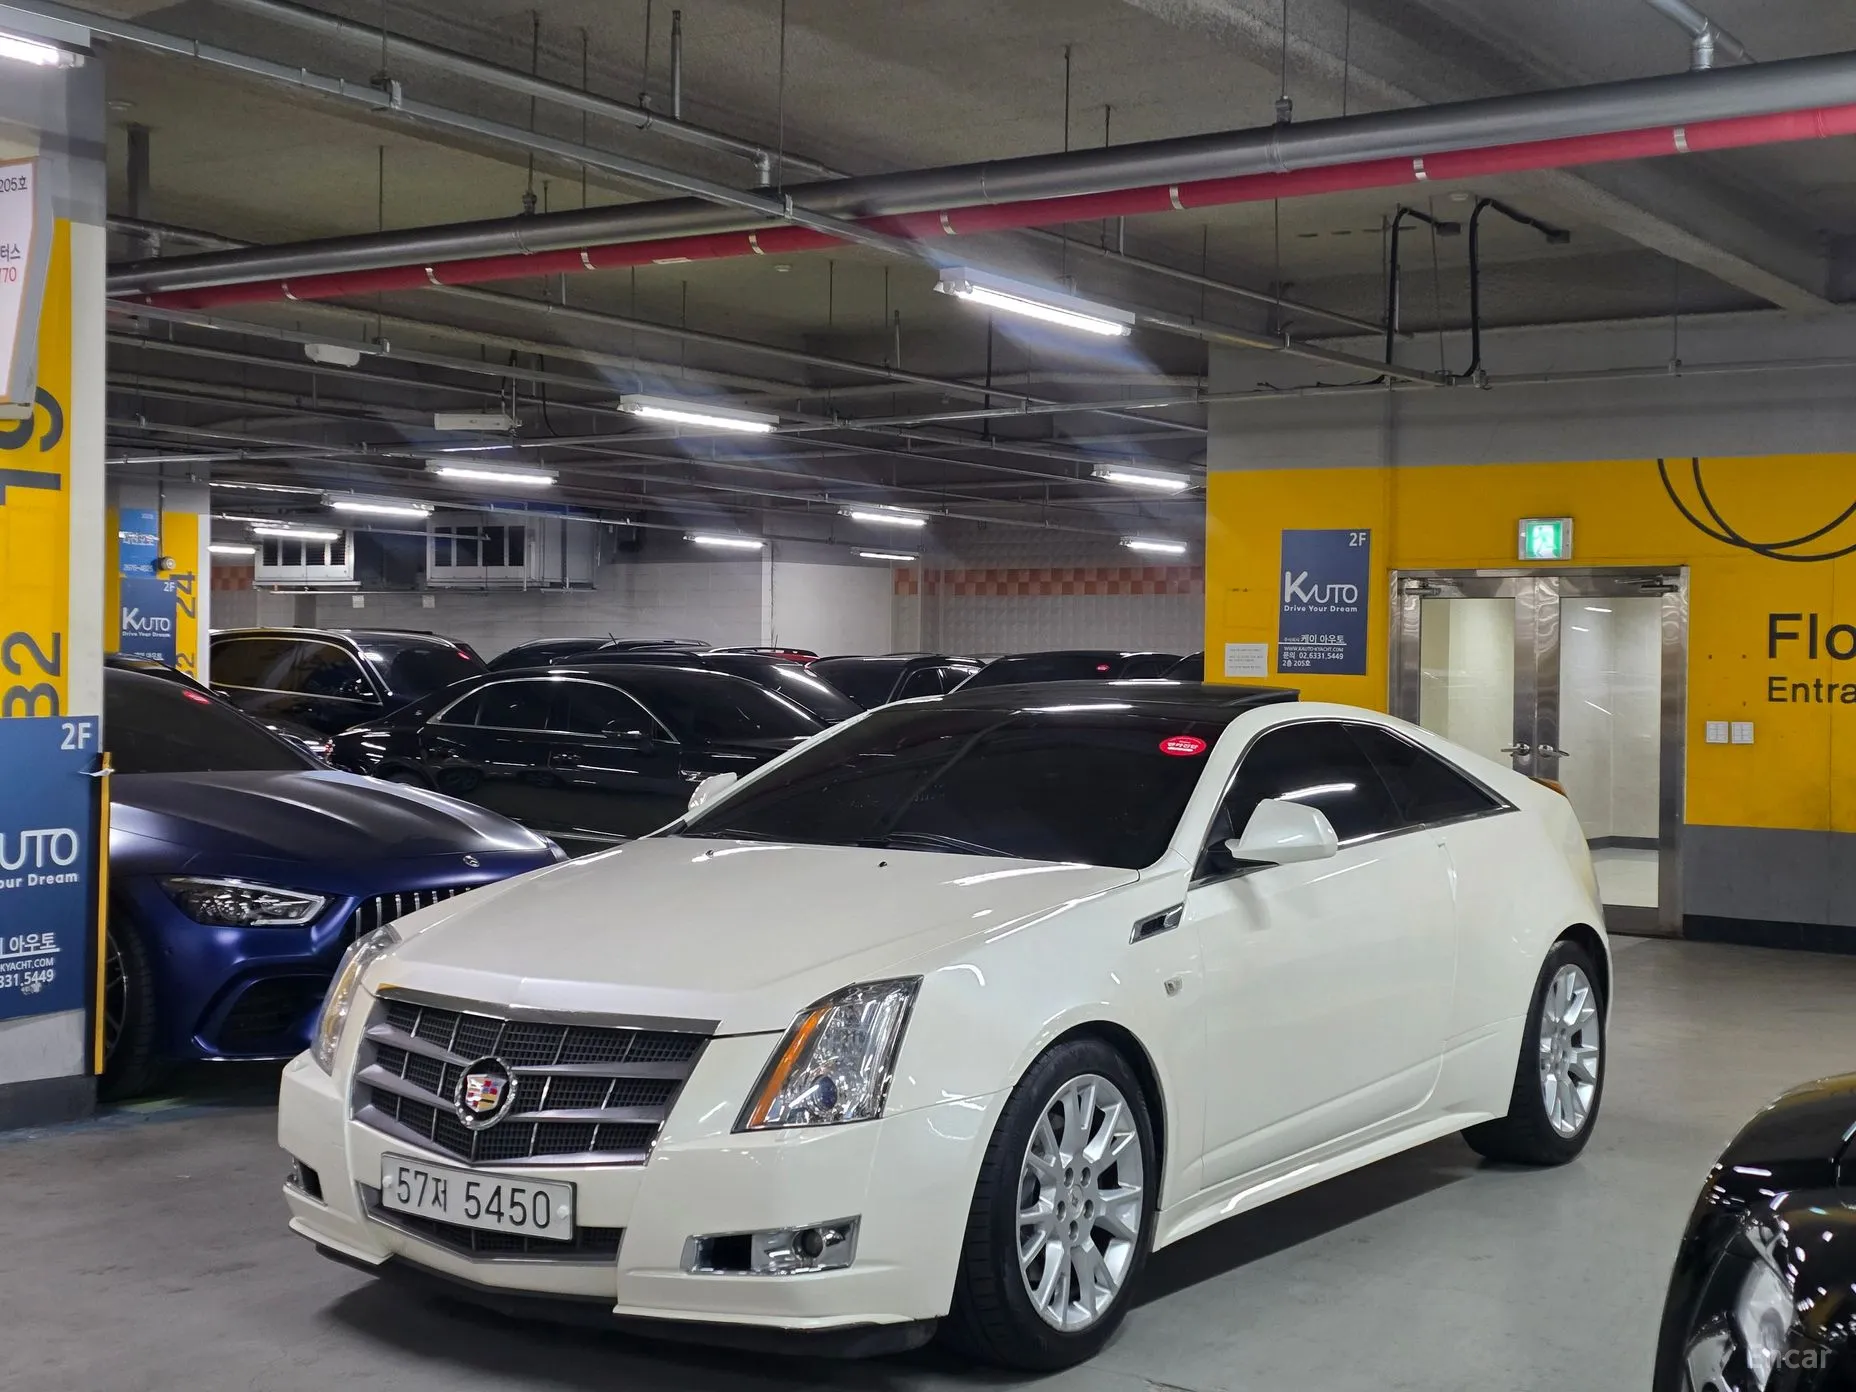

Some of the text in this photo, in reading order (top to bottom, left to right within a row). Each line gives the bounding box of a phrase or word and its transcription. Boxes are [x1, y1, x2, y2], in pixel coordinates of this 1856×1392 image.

[1348, 532, 1367, 547] 2F
[163, 581, 175, 592] 2F
[1283, 604, 1358, 613] Drive Your Dream
[1319, 634, 1345, 644] 아우토
[1298, 652, 1344, 660] 02.6331.5449
[60, 722, 92, 750] 2F
[27, 872, 78, 887] Dream
[9, 932, 57, 954] 아우토
[397, 1166, 551, 1229] 57저 5450
